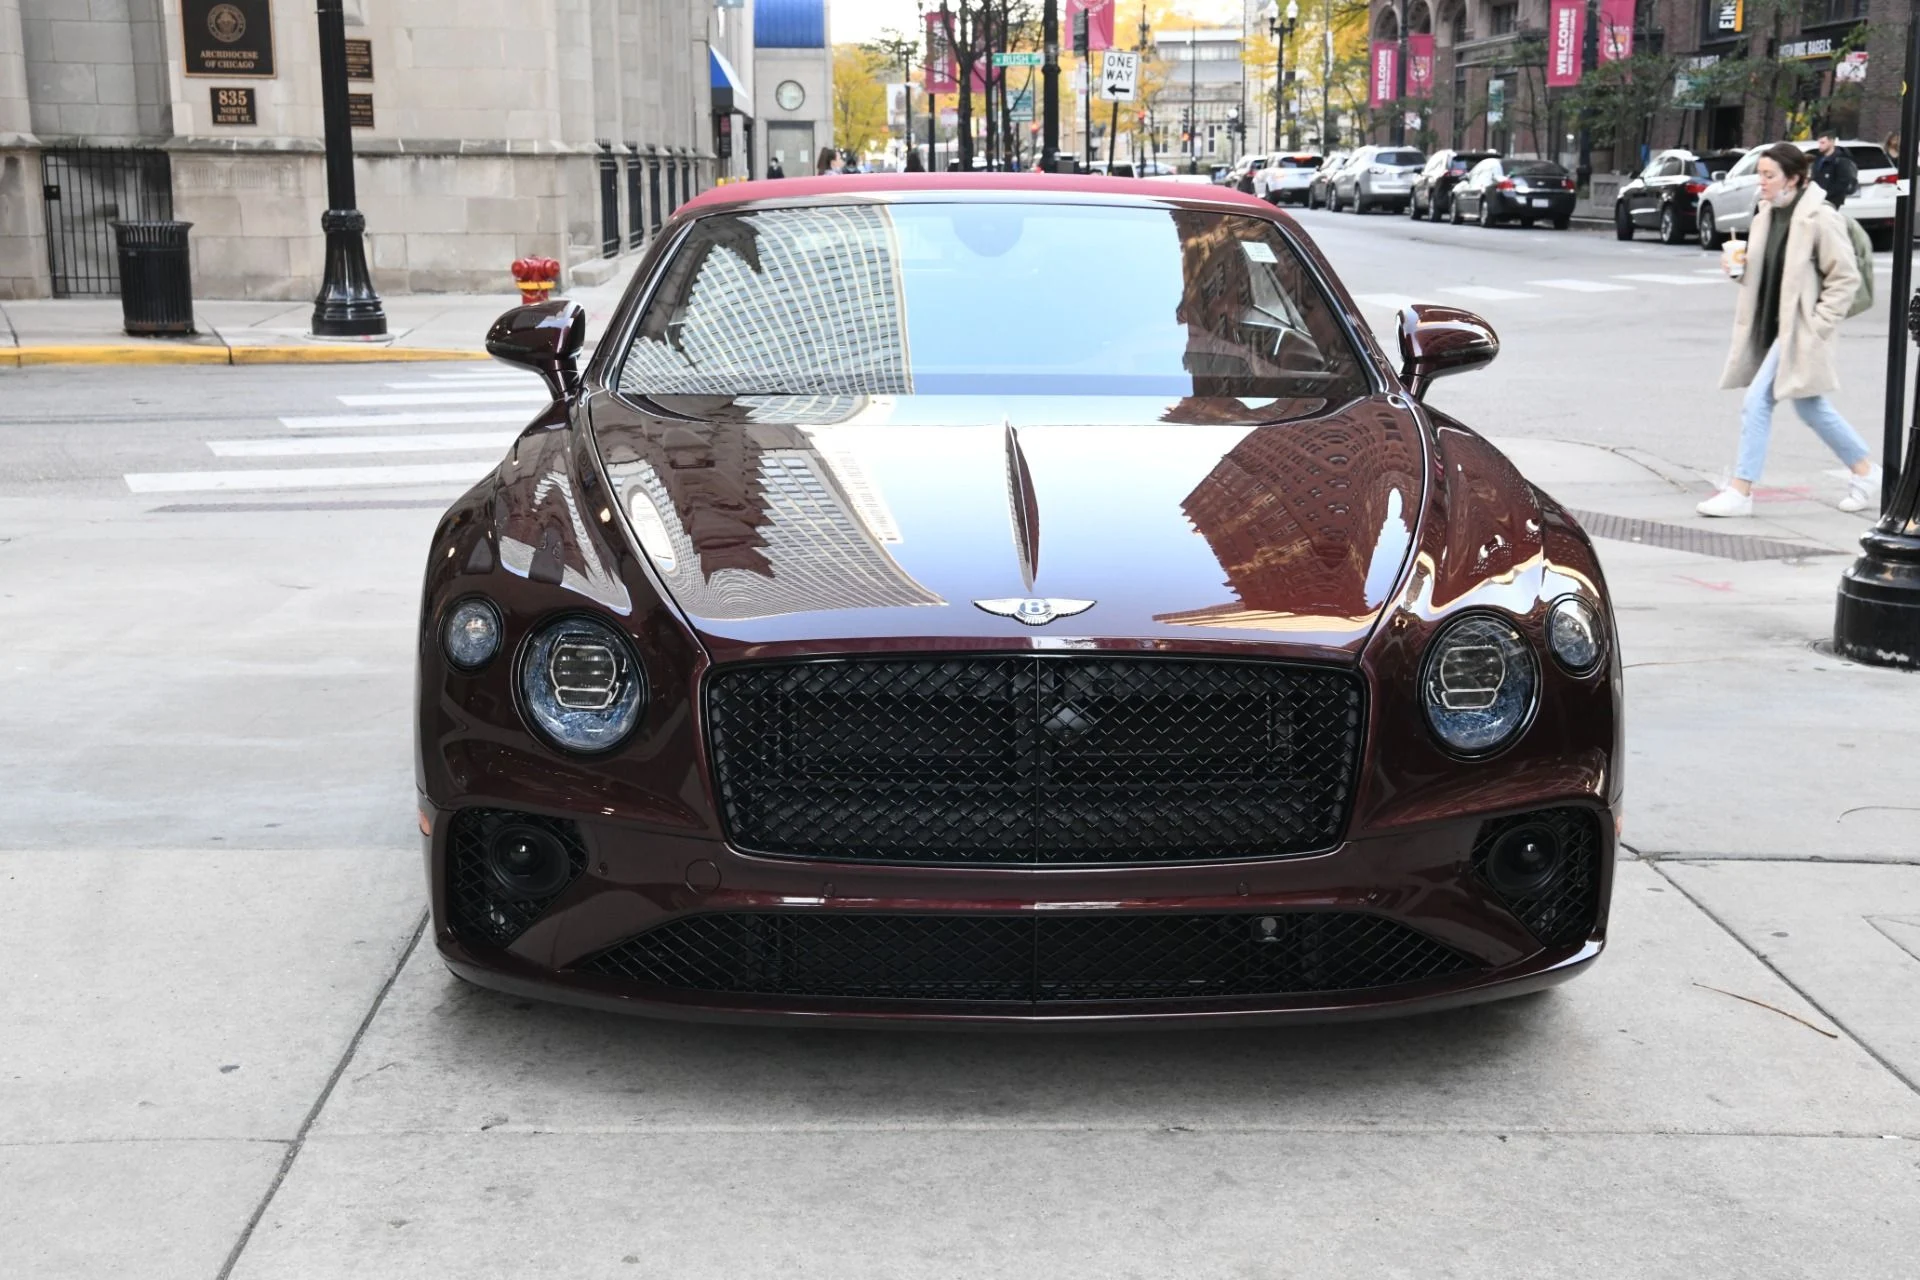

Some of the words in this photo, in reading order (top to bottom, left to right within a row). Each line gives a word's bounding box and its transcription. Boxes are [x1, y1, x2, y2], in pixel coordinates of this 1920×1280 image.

[1556, 8, 1570, 76] WELCOME
[1807, 38, 1832, 54] BAGELS
[200, 50, 258, 59] ARCHDIOCESE
[1003, 55, 1029, 65] RUSH
[204, 60, 216, 68] OF
[217, 60, 255, 69] CHICAGO
[1107, 55, 1133, 68] ONE
[1106, 69, 1133, 81] WAY
[1377, 49, 1388, 100] WELCOME
[219, 90, 247, 106] 835
